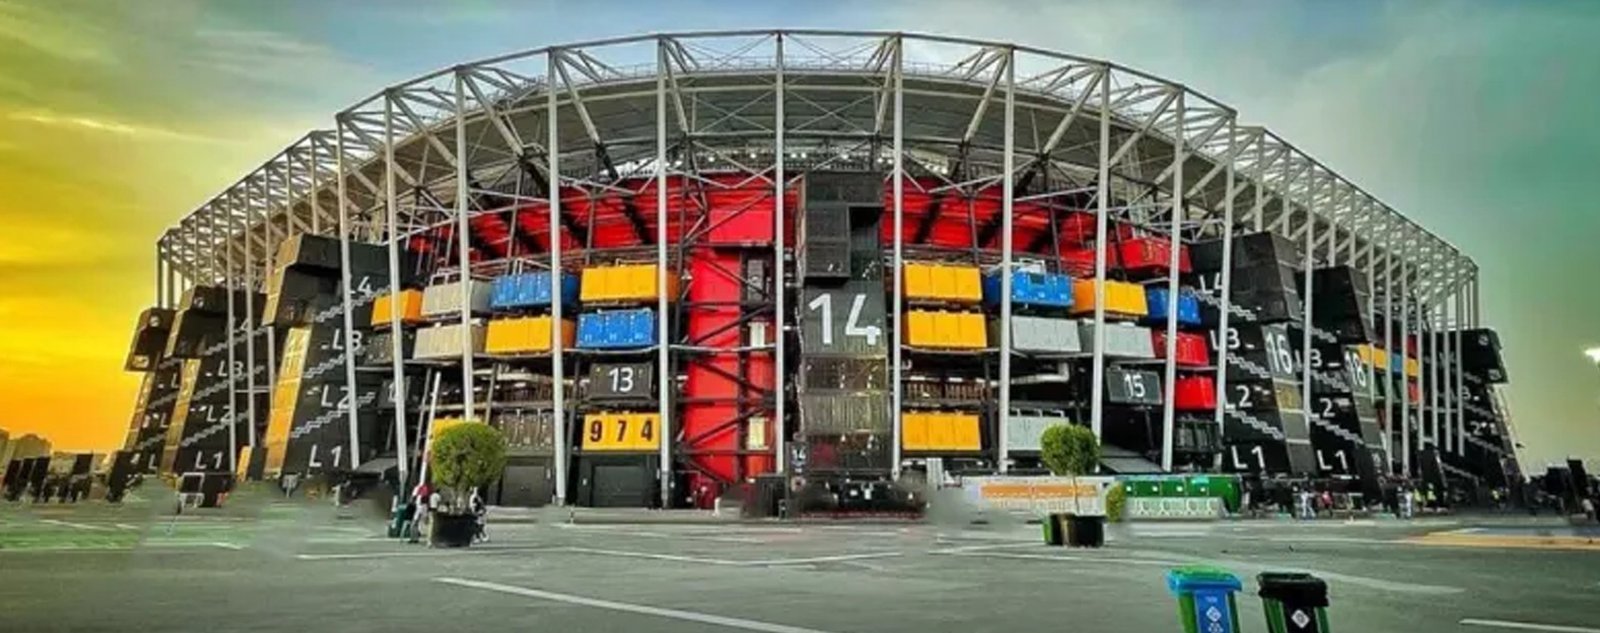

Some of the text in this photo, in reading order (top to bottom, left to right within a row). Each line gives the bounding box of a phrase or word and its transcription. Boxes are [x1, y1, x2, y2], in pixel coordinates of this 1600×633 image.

[809, 293, 882, 346] 14
[332, 329, 363, 351] L3
[1210, 328, 1240, 350] L3
[1265, 332, 1293, 374] 16
[608, 366, 634, 392] 13
[1123, 373, 1146, 398] 15
[321, 384, 351, 409] L2
[206, 405, 232, 422] L2
[195, 451, 223, 470] L1
[309, 445, 342, 468] L1
[1231, 445, 1267, 469] L1
[1317, 449, 1349, 471] L1
